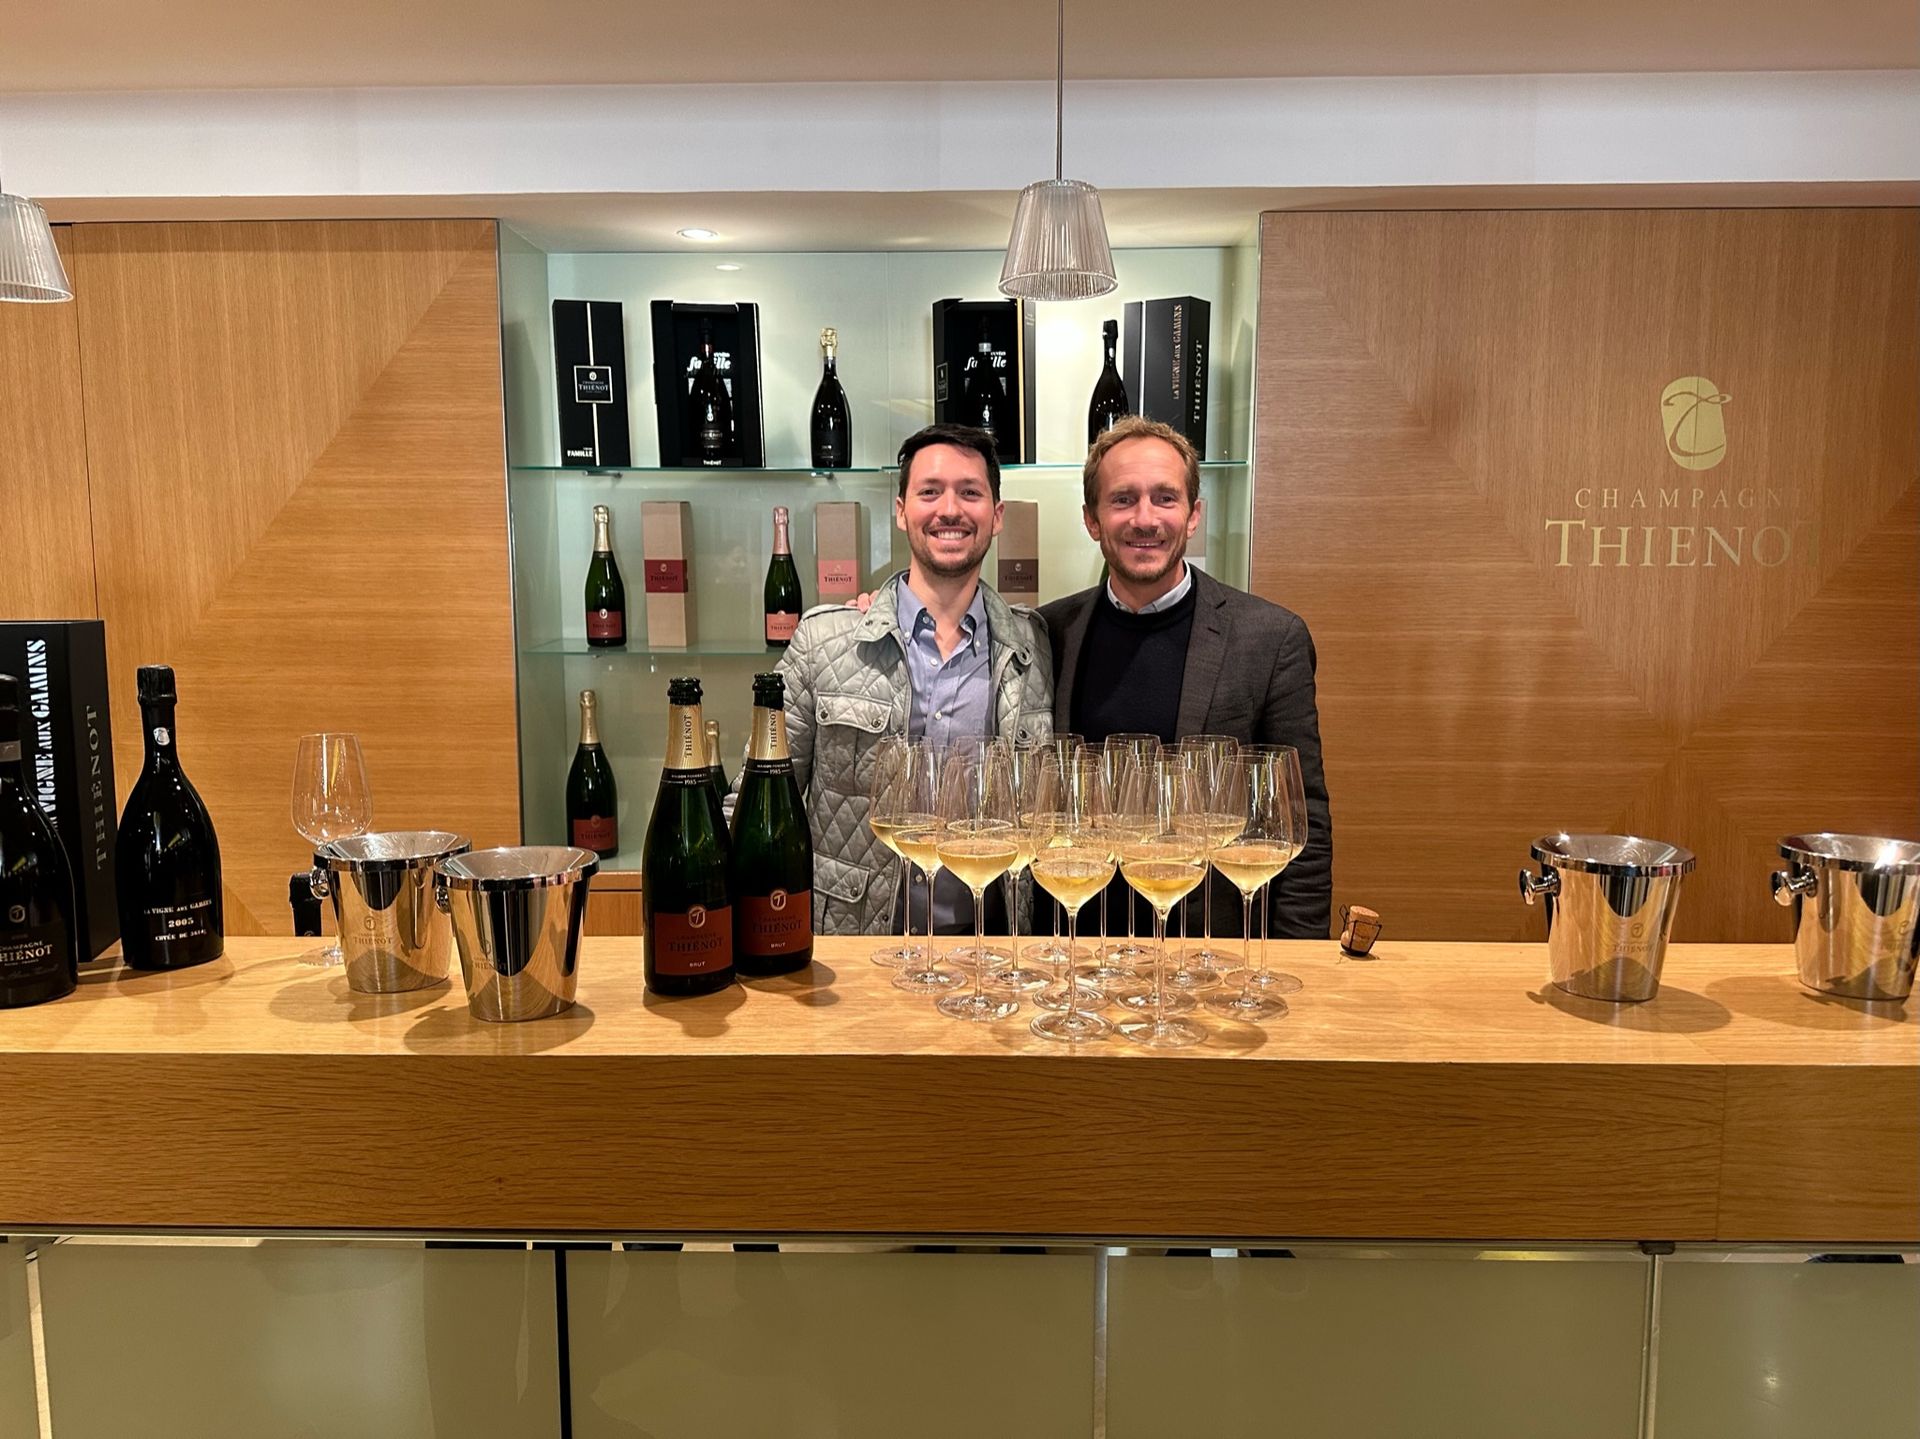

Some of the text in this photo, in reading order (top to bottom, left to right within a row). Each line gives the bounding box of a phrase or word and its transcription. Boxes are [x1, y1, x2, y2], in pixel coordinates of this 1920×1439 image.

[687, 356, 731, 371] falle
[963, 356, 1007, 371] falle
[26, 638, 51, 719] GAMINS
[37, 721, 52, 750] AUX
[34, 753, 57, 814] VIGNE
[0, 944, 53, 962] HIÉNOT
